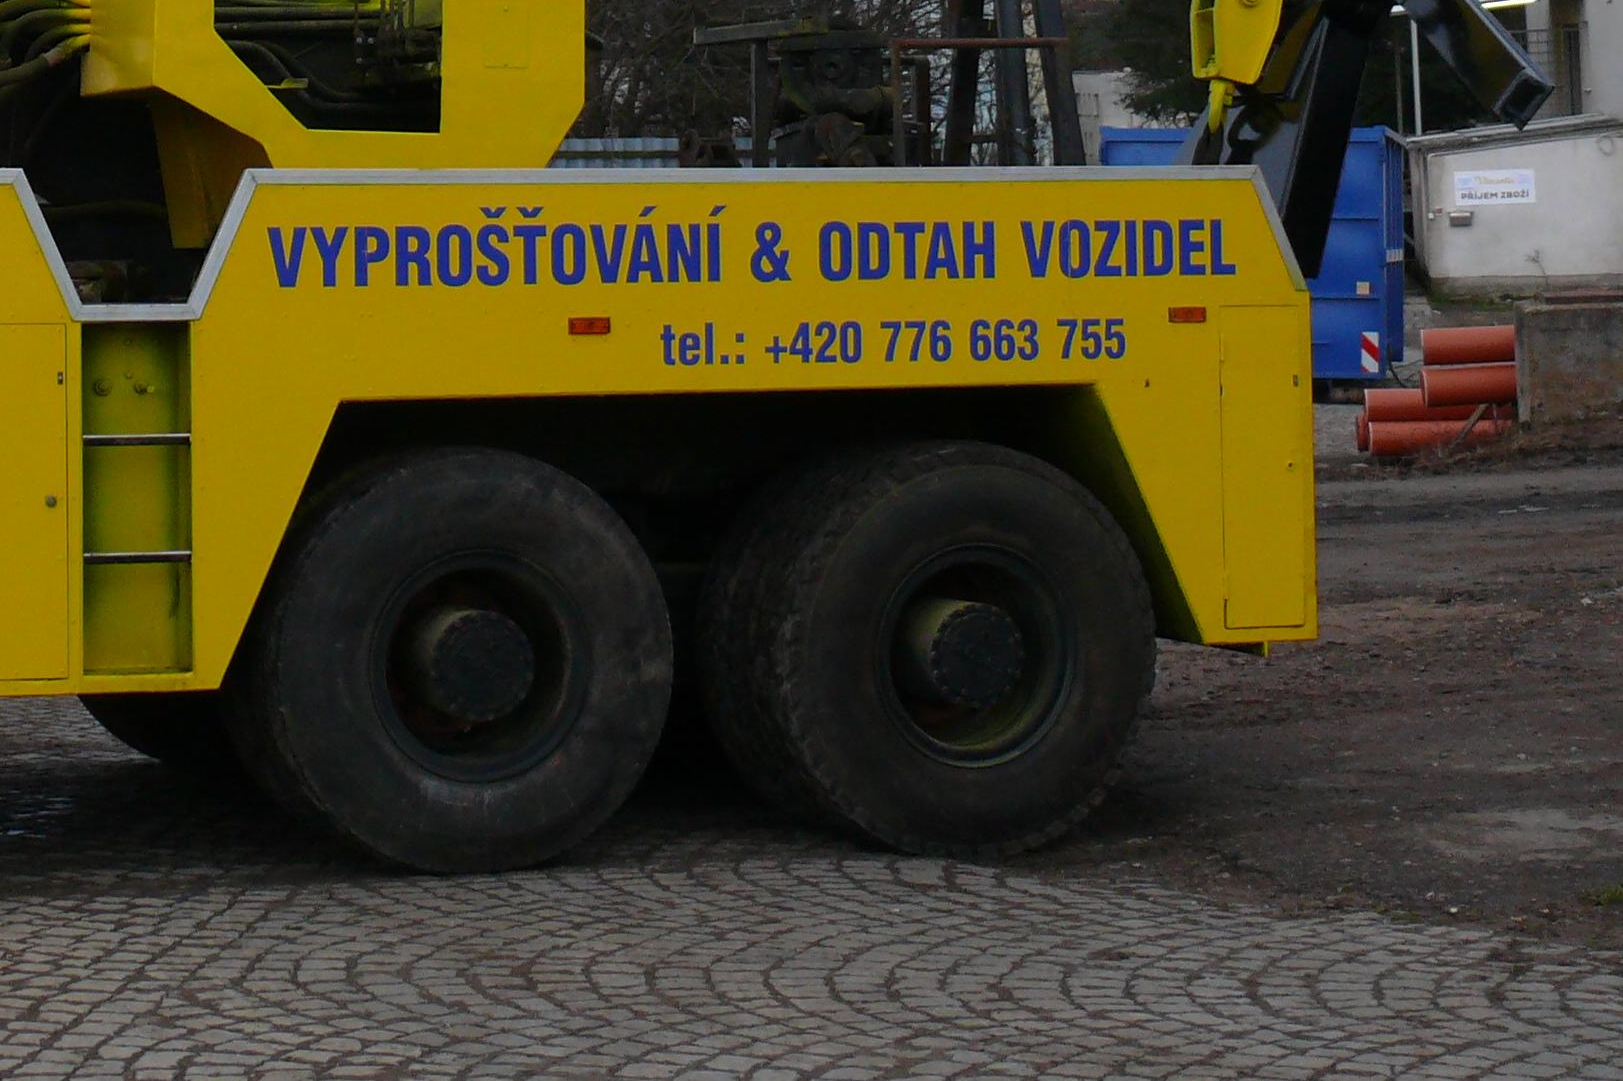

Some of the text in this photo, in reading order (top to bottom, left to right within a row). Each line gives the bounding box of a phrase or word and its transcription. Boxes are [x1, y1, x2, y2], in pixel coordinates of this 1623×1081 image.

[1460, 189, 1498, 200] PŘÍJEM
[267, 206, 1236, 287] VYPROŠŤOVÁNÍ & ODTAH VOZIDEL
[662, 319, 1126, 366] tel.: +420 776 663 755
